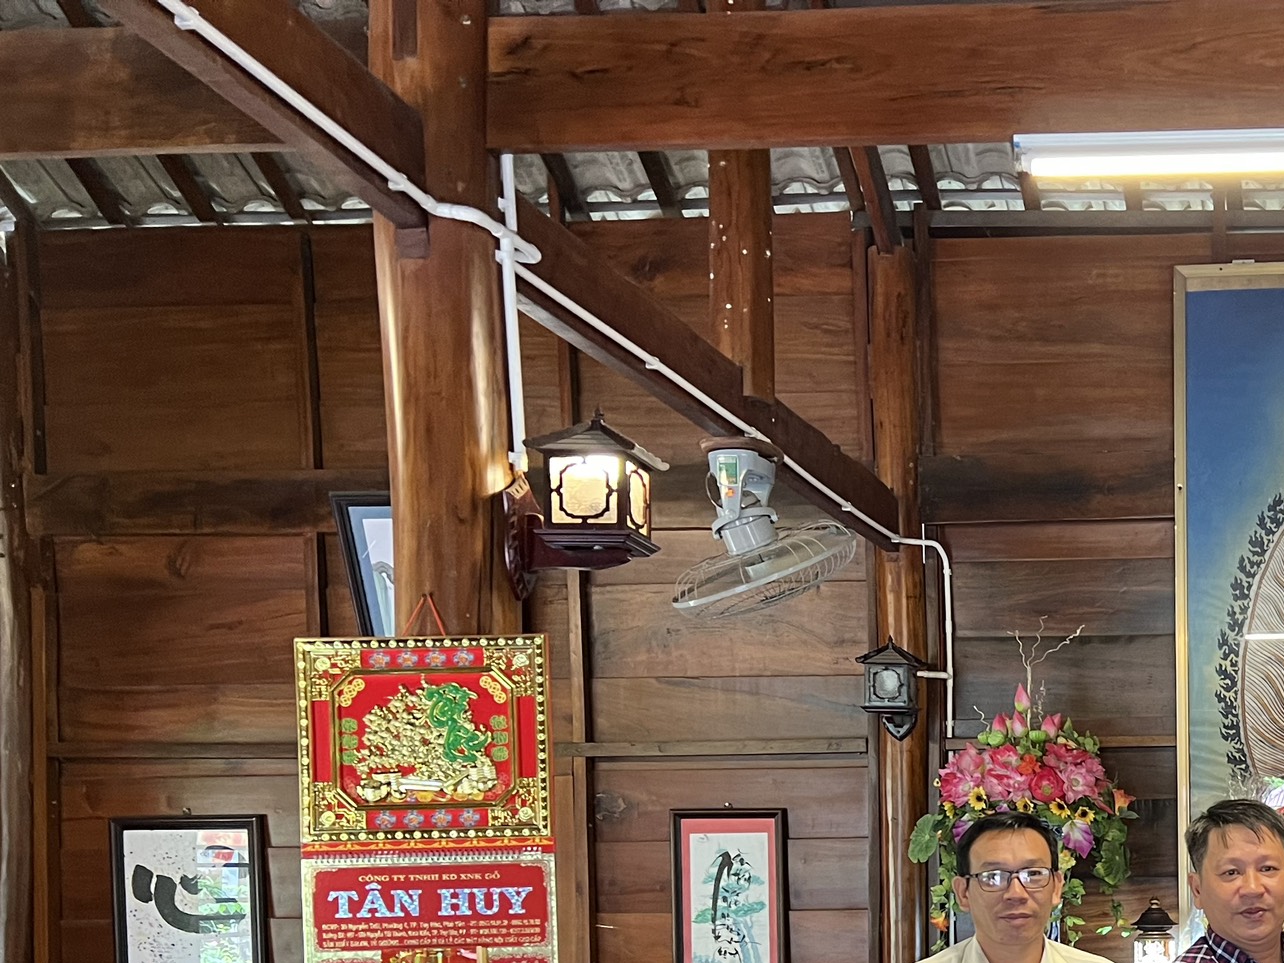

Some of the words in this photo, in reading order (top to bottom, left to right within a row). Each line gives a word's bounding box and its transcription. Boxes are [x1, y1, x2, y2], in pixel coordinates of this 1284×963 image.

[358, 874, 390, 882] CÔNG
[392, 874, 406, 882] TY
[460, 873, 483, 881] XNK
[327, 882, 422, 919] TÂN
[437, 887, 533, 916] HUY
